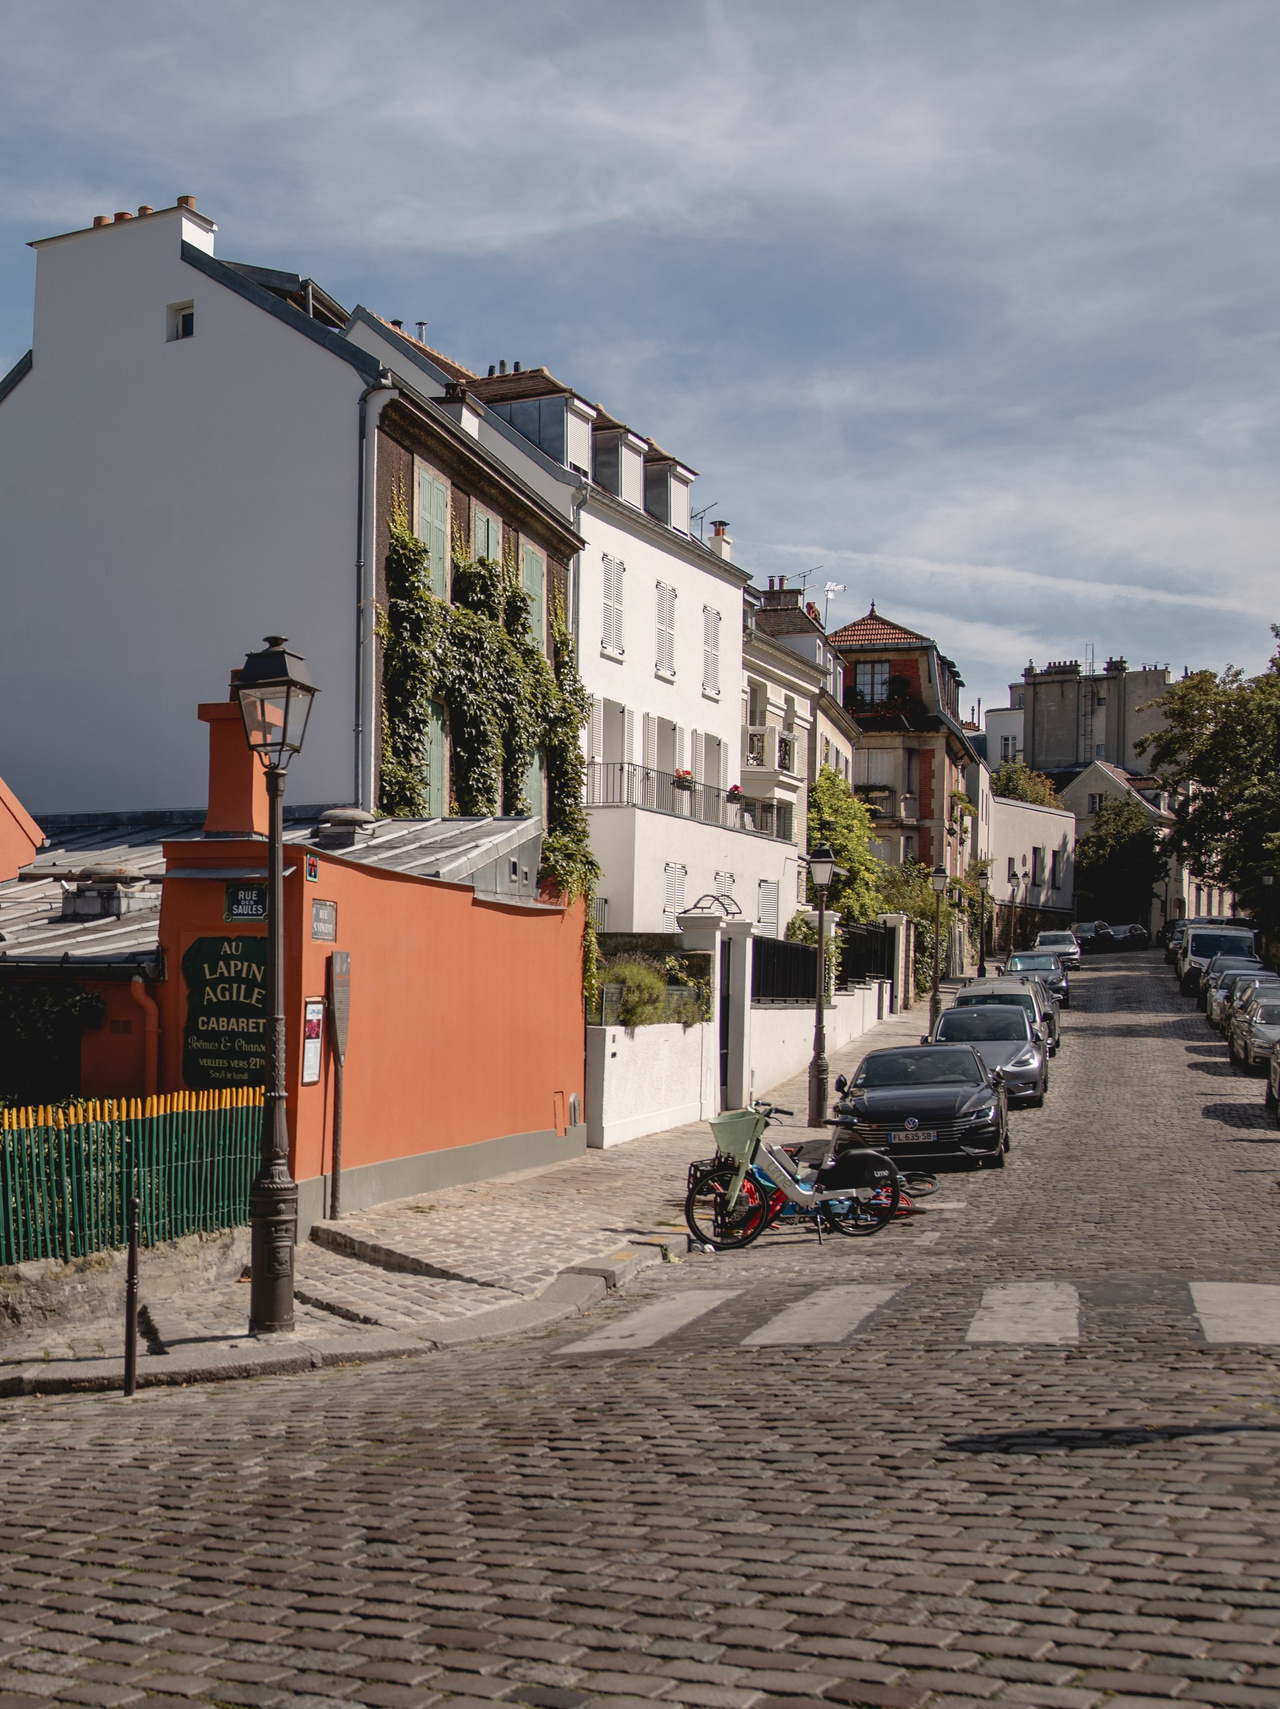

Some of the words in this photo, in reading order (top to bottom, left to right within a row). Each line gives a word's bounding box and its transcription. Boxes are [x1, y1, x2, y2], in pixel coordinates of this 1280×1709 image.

[238, 890, 258, 900] RUE
[232, 904, 263, 915] SAULES
[220, 941, 243, 955] AU
[202, 960, 265, 983] LAPIN
[203, 983, 266, 1008] AGILE
[198, 1016, 267, 1033] CABARET
[220, 1035, 232, 1051] &
[230, 1059, 249, 1069] VERS
[209, 1069, 225, 1079] Sauf
[226, 1071, 232, 1079] le
[232, 1071, 249, 1080] lundi
